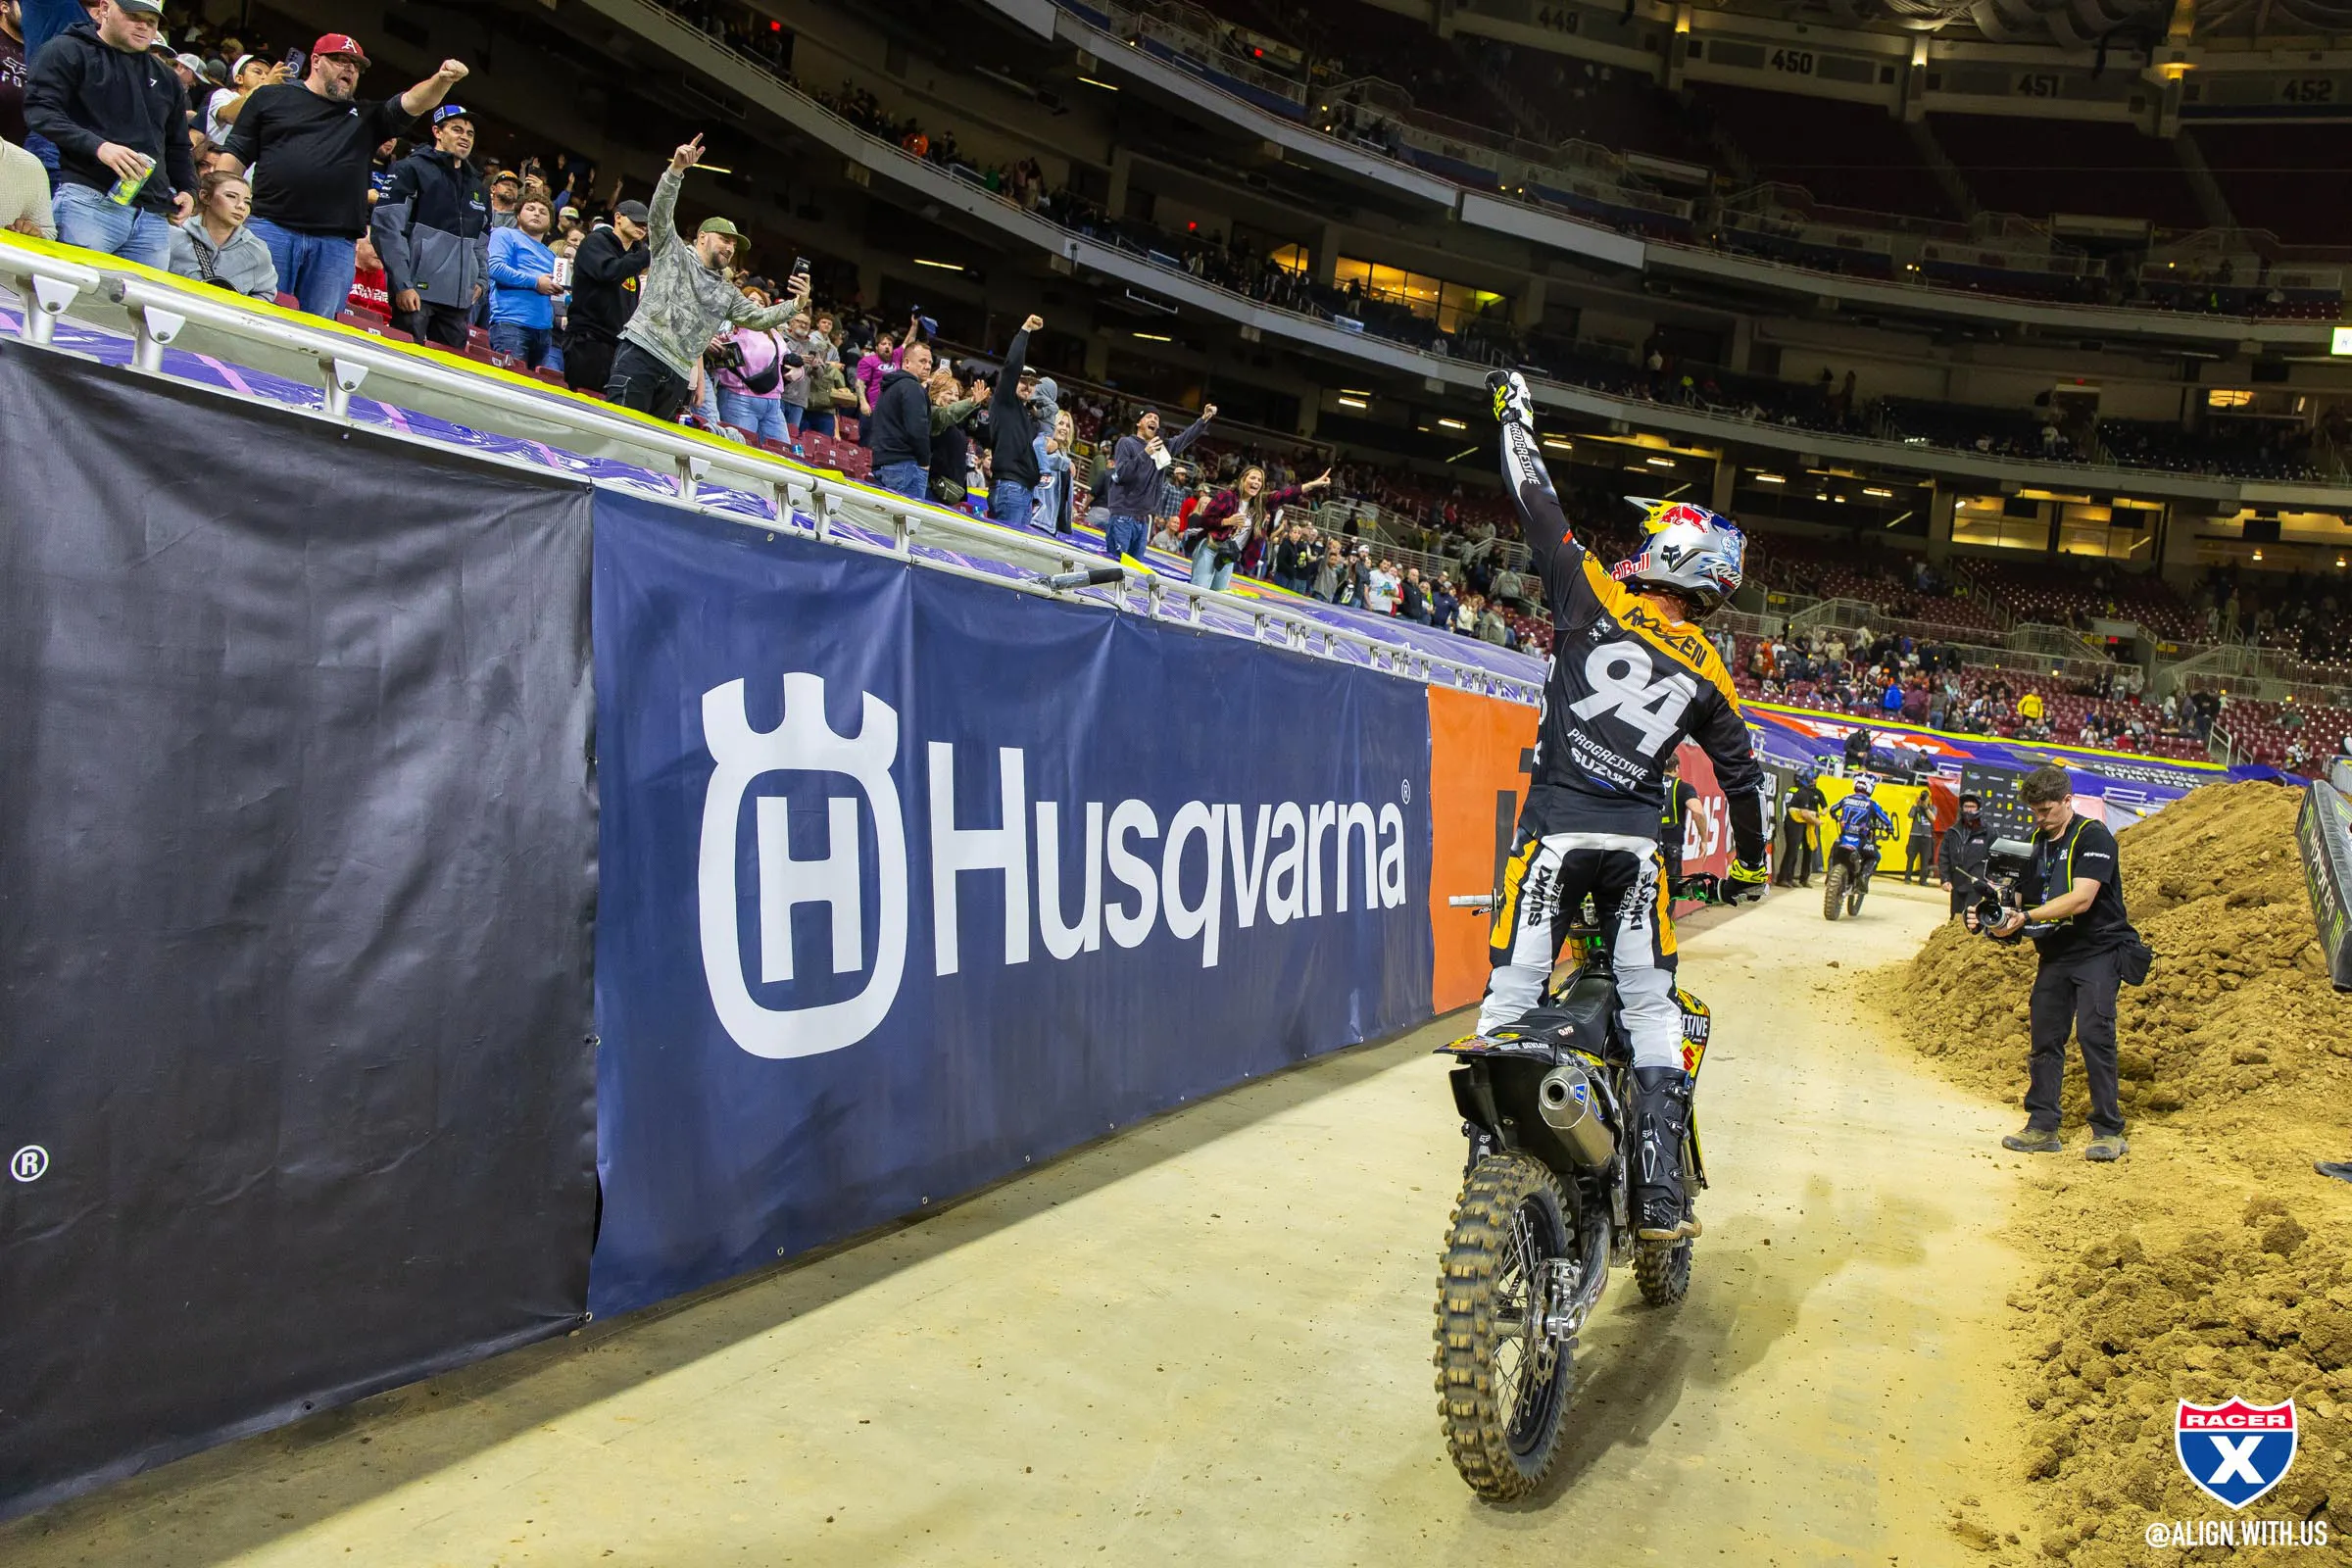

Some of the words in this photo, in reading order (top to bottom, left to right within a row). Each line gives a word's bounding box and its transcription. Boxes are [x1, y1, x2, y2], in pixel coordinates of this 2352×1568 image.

[1538, 5, 1579, 33] 449
[341, 37, 358, 53] A
[1770, 49, 1813, 74] 450
[1, 71, 27, 87] FO
[2017, 74, 2059, 97] 451
[2280, 79, 2333, 102] 452
[1510, 421, 1541, 485] PROGRESSIVE
[1569, 640, 1697, 758] 94
[1567, 728, 1648, 780] PROGRESSIVE
[1570, 747, 1636, 790] SUZUKI
[1842, 805, 1868, 826] 17
